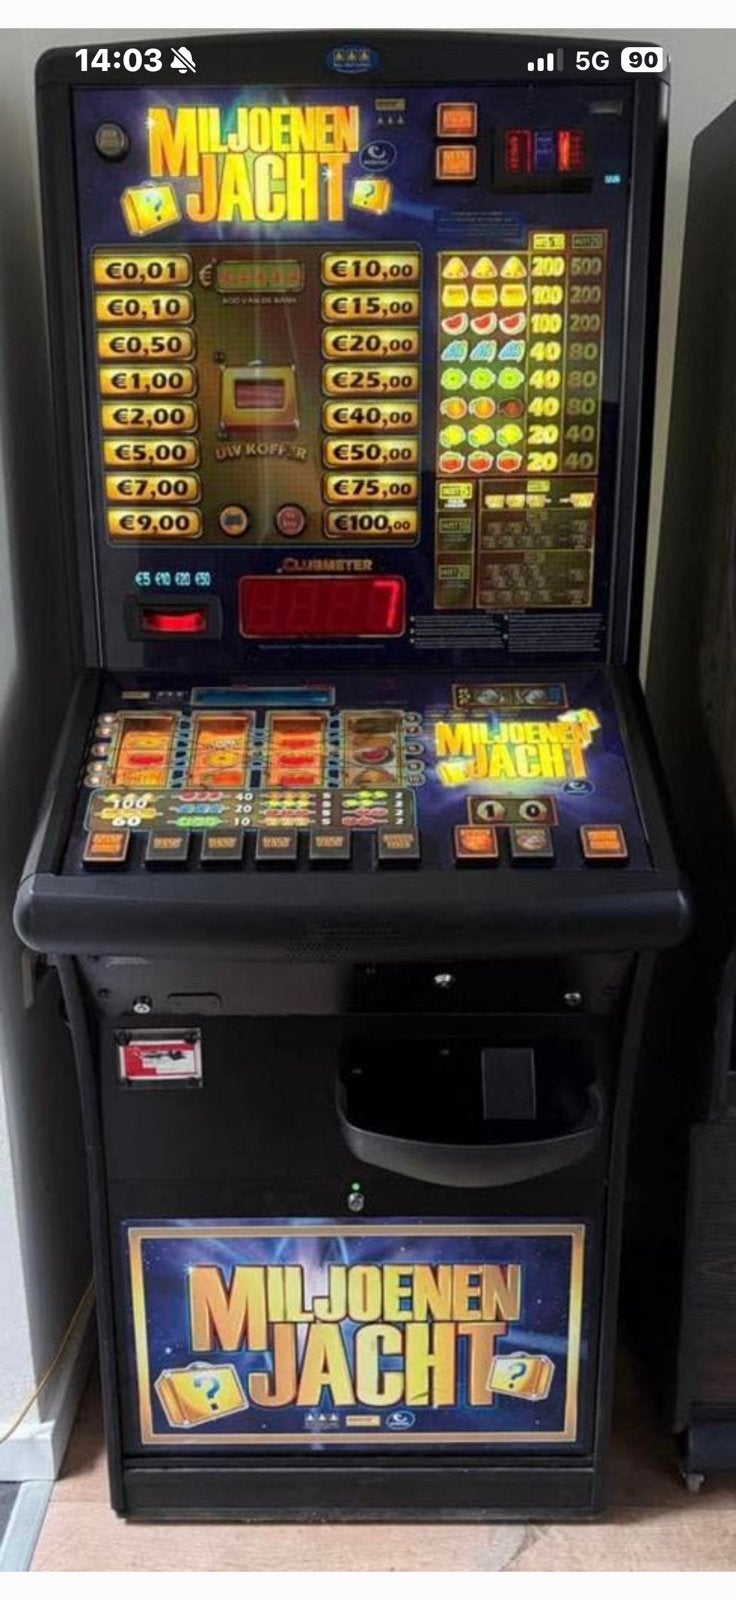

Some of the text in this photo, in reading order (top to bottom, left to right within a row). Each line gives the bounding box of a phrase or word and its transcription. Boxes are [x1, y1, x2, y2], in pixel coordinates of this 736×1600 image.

[147, 105, 359, 177] MILJOENEN
[186, 152, 351, 223] JACHT
[106, 261, 177, 283] €0,01
[331, 260, 413, 280] €10,00
[531, 256, 565, 277] 200
[571, 257, 601, 276] 500
[531, 285, 563, 305] 100
[570, 286, 600, 304] 200
[108, 298, 181, 319] €0,10
[331, 297, 413, 317] €15,00
[531, 313, 562, 333] 100
[570, 314, 600, 331] 200
[109, 335, 182, 356] €0,50
[332, 334, 413, 354] €20,00
[530, 341, 561, 361] 40
[569, 343, 598, 360] 80
[111, 371, 184, 392] €1,00
[332, 371, 413, 390] €25,00
[529, 369, 560, 389] 40
[567, 370, 597, 388] 80
[528, 397, 560, 416] 40
[566, 398, 596, 415] 80
[112, 407, 185, 428] €2,00
[332, 407, 413, 427] €40,00
[527, 424, 559, 444] 20
[566, 425, 595, 442] 40
[115, 444, 187, 464] €5,00
[215, 444, 242, 460] UW
[333, 444, 413, 464] €50,00
[527, 451, 558, 471] 20
[565, 452, 593, 470] 40
[117, 480, 188, 499] €7,00
[333, 479, 412, 499] €75,00
[119, 514, 190, 534] €9,00
[335, 515, 411, 534] €100,00
[436, 721, 590, 757] MILJOENEN
[468, 744, 587, 778] JACHT
[113, 799, 148, 809] 100
[235, 792, 253, 800] 40
[234, 804, 252, 813] 20
[484, 804, 494, 818] 1
[112, 816, 141, 827] 60
[234, 817, 250, 826] 10
[190, 1264, 521, 1352] MILJOENEN
[249, 1321, 507, 1407] JACHT
